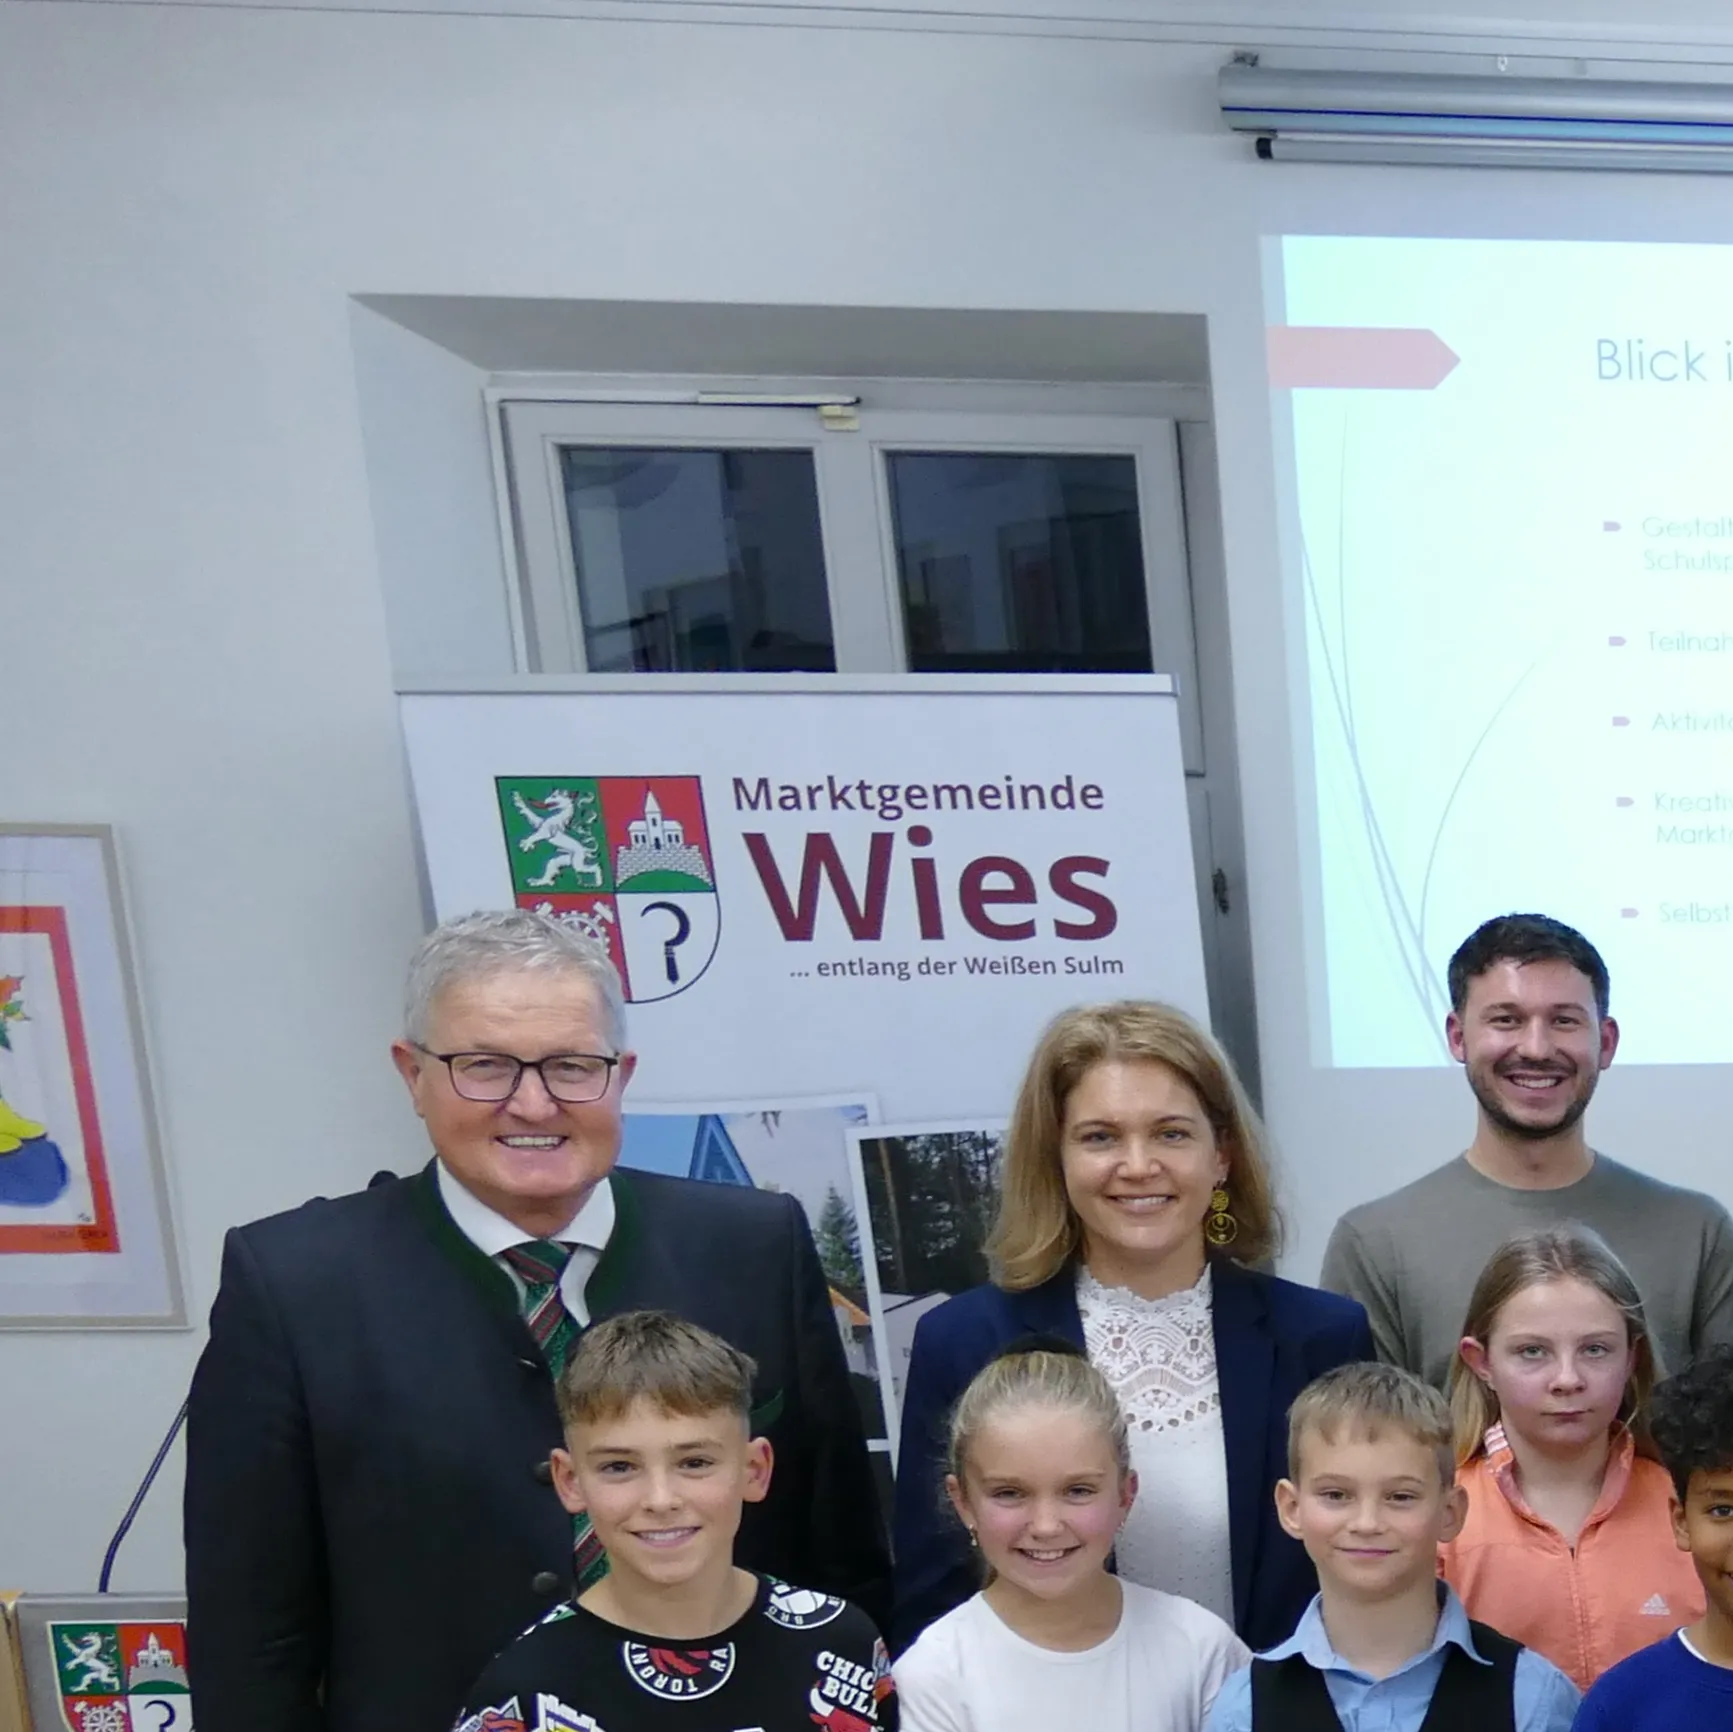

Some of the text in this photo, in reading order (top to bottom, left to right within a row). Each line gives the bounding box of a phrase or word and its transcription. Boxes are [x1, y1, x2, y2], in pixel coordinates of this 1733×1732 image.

[1596, 338, 1707, 382] Blick
[732, 774, 1104, 821] Marktgemeinde
[743, 825, 1119, 943] Wies
[1658, 901, 1733, 924] Selbst
[816, 956, 911, 981] entlang
[917, 956, 958, 976] der
[965, 955, 1058, 976] Weißen
[1065, 955, 1124, 976] Sulm
[631, 1643, 699, 1693] TORONT
[822, 1676, 878, 1721] BULL
